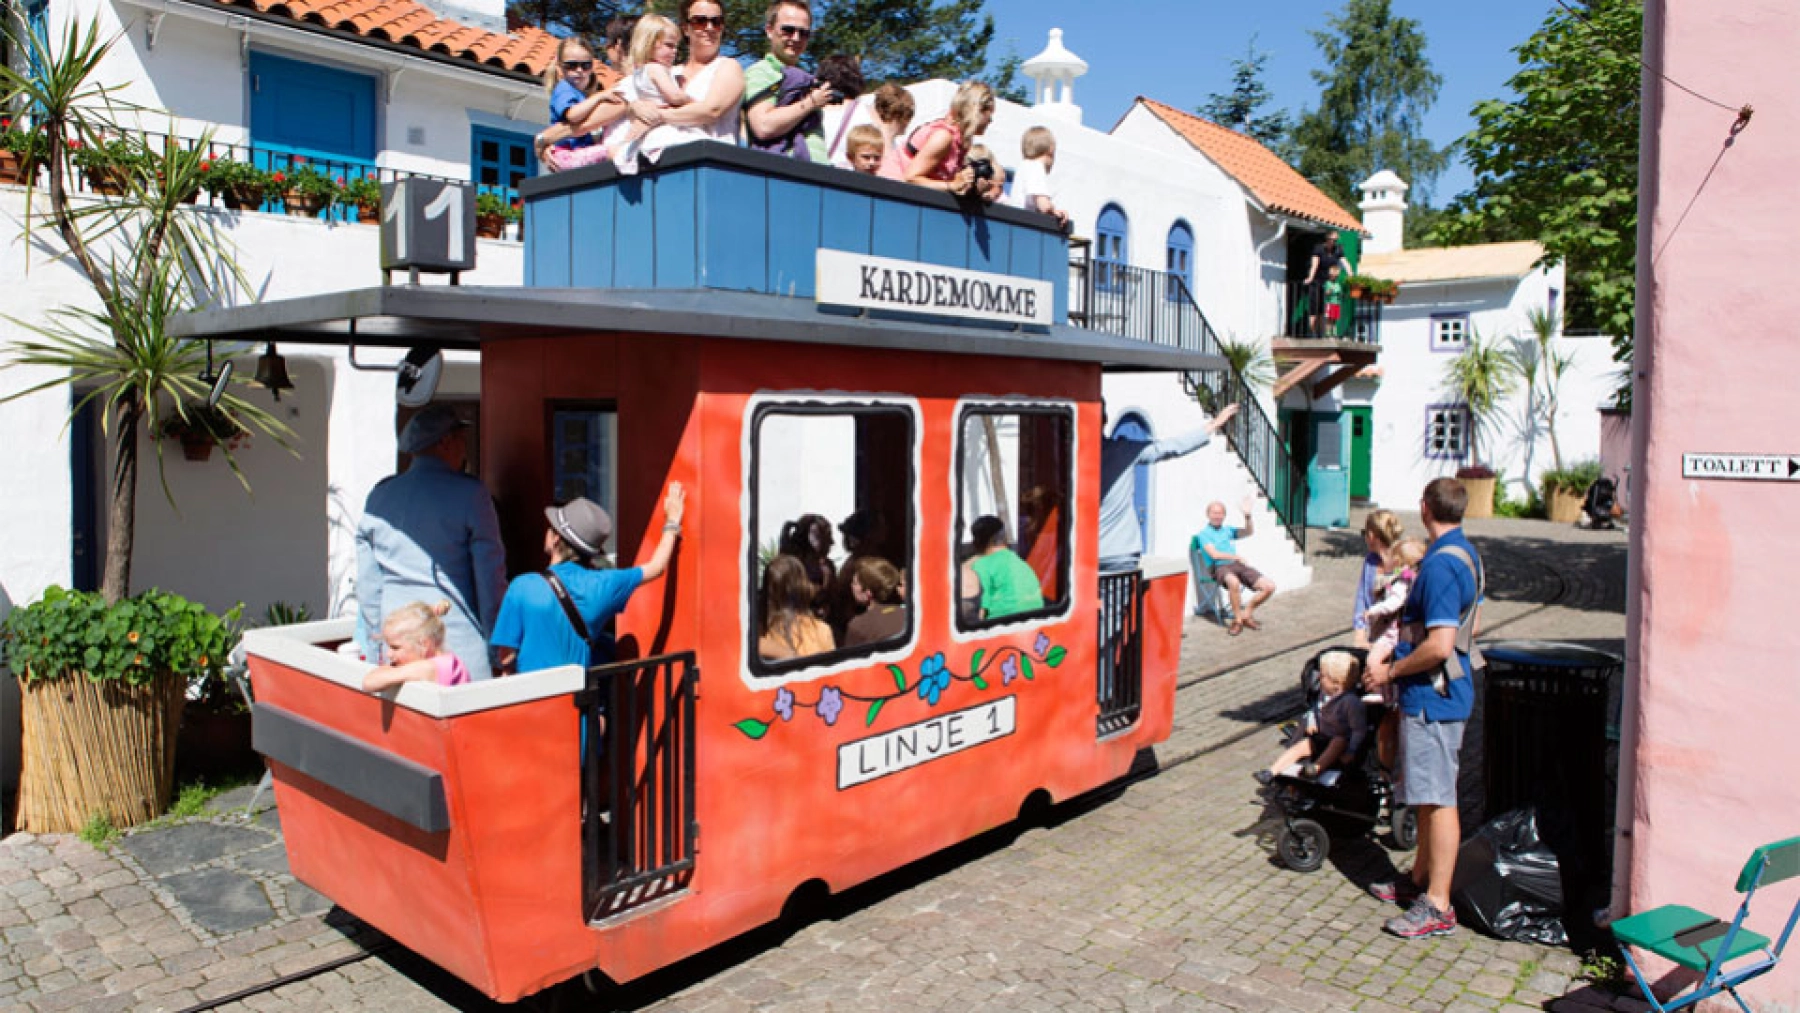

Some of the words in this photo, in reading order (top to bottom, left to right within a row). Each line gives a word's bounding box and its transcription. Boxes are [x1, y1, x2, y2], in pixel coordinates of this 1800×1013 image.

[859, 265, 1037, 318] KARDEMOMME
[1689, 458, 1781, 473] TOALETT
[859, 715, 964, 774] LINJE
[986, 706, 1000, 734] 1
